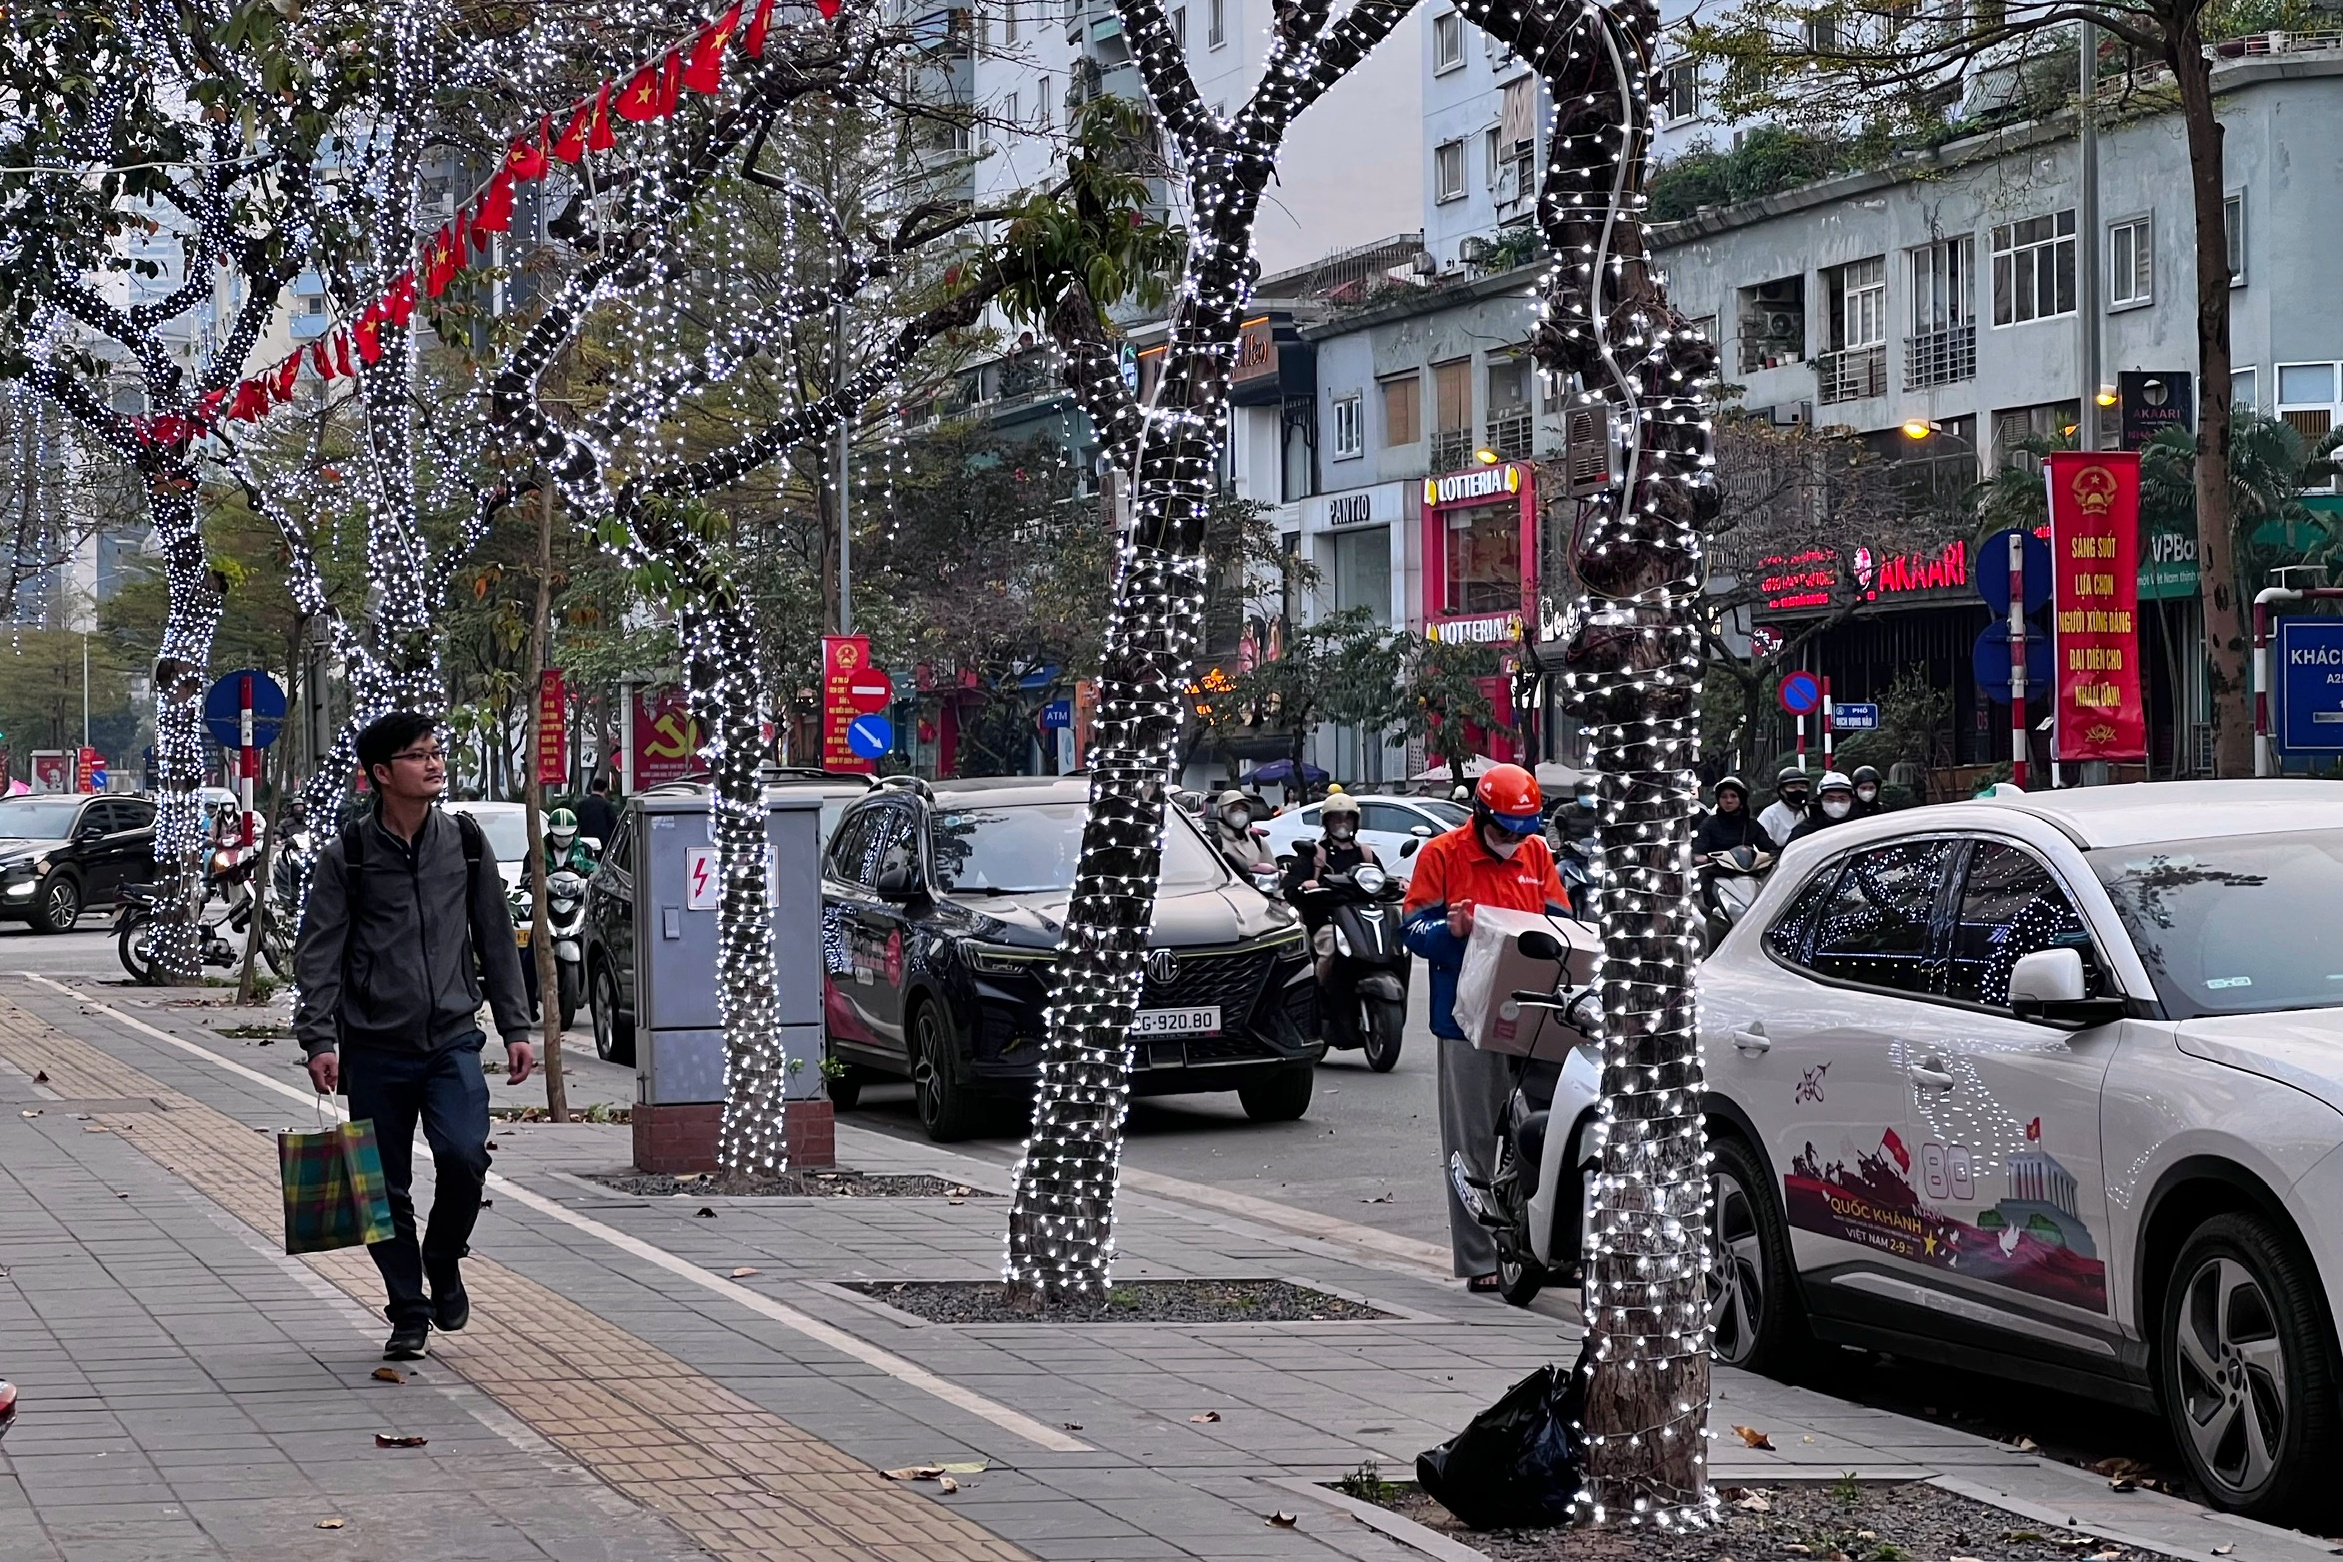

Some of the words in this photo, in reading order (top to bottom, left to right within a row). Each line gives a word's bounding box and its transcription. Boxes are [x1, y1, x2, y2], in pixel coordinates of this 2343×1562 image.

[2133, 408, 2180, 419] AKAARI
[1439, 469, 1502, 502] LOTTERIA
[1330, 494, 1370, 525] PANTIO
[2071, 533, 2096, 559] SÁNG
[2097, 529, 2117, 559] SUỐT
[1879, 541, 1966, 592] AKAARI
[2075, 571, 2093, 600] LỰA
[2094, 573, 2114, 600] CHỌN
[2058, 606, 2085, 633] NGƯỜI
[2086, 606, 2108, 633] XỨNG
[2109, 606, 2132, 634] ĐÁNG
[2069, 648, 2085, 675] ĐẠI
[2086, 644, 2106, 675] DIỆN
[2106, 648, 2123, 671] CHO
[2291, 644, 2343, 665] KHÁC
[2075, 681, 2100, 707] NHÂN
[2100, 681, 2121, 707] DÂN!
[1046, 711, 1068, 721] ATM
[1852, 704, 1868, 714] PHỐ
[1150, 952, 1178, 980] MG
[1921, 1143, 1975, 1200] 80
[1830, 1197, 1871, 1220] QUỐC
[1873, 1208, 1922, 1234] KHÁNH
[1845, 1227, 1867, 1243] VIỆT
[1868, 1233, 1889, 1248] NAM
[1890, 1238, 1906, 1254] 2-9
